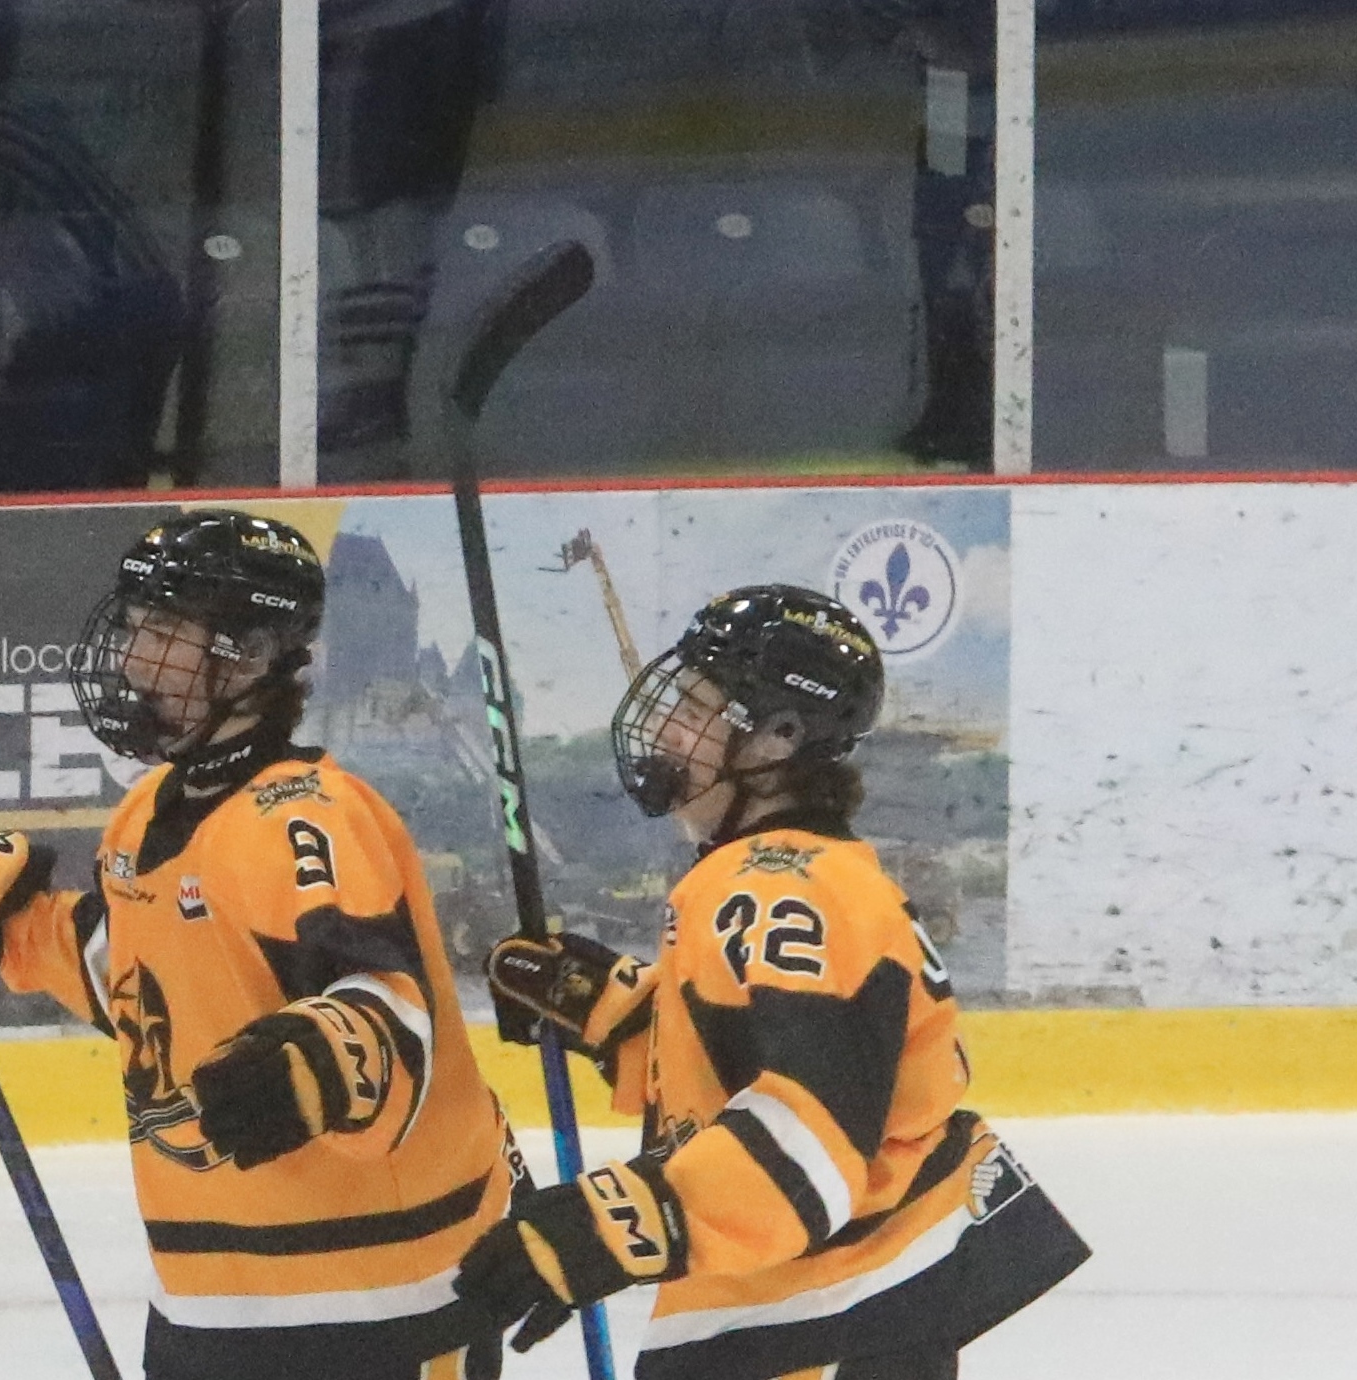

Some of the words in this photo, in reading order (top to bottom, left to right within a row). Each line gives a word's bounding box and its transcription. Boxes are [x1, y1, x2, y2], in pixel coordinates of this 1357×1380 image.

[122, 558, 154, 575] CCM
[250, 592, 298, 611] CCM
[784, 673, 838, 700] CCM
[477, 635, 528, 856] CCM
